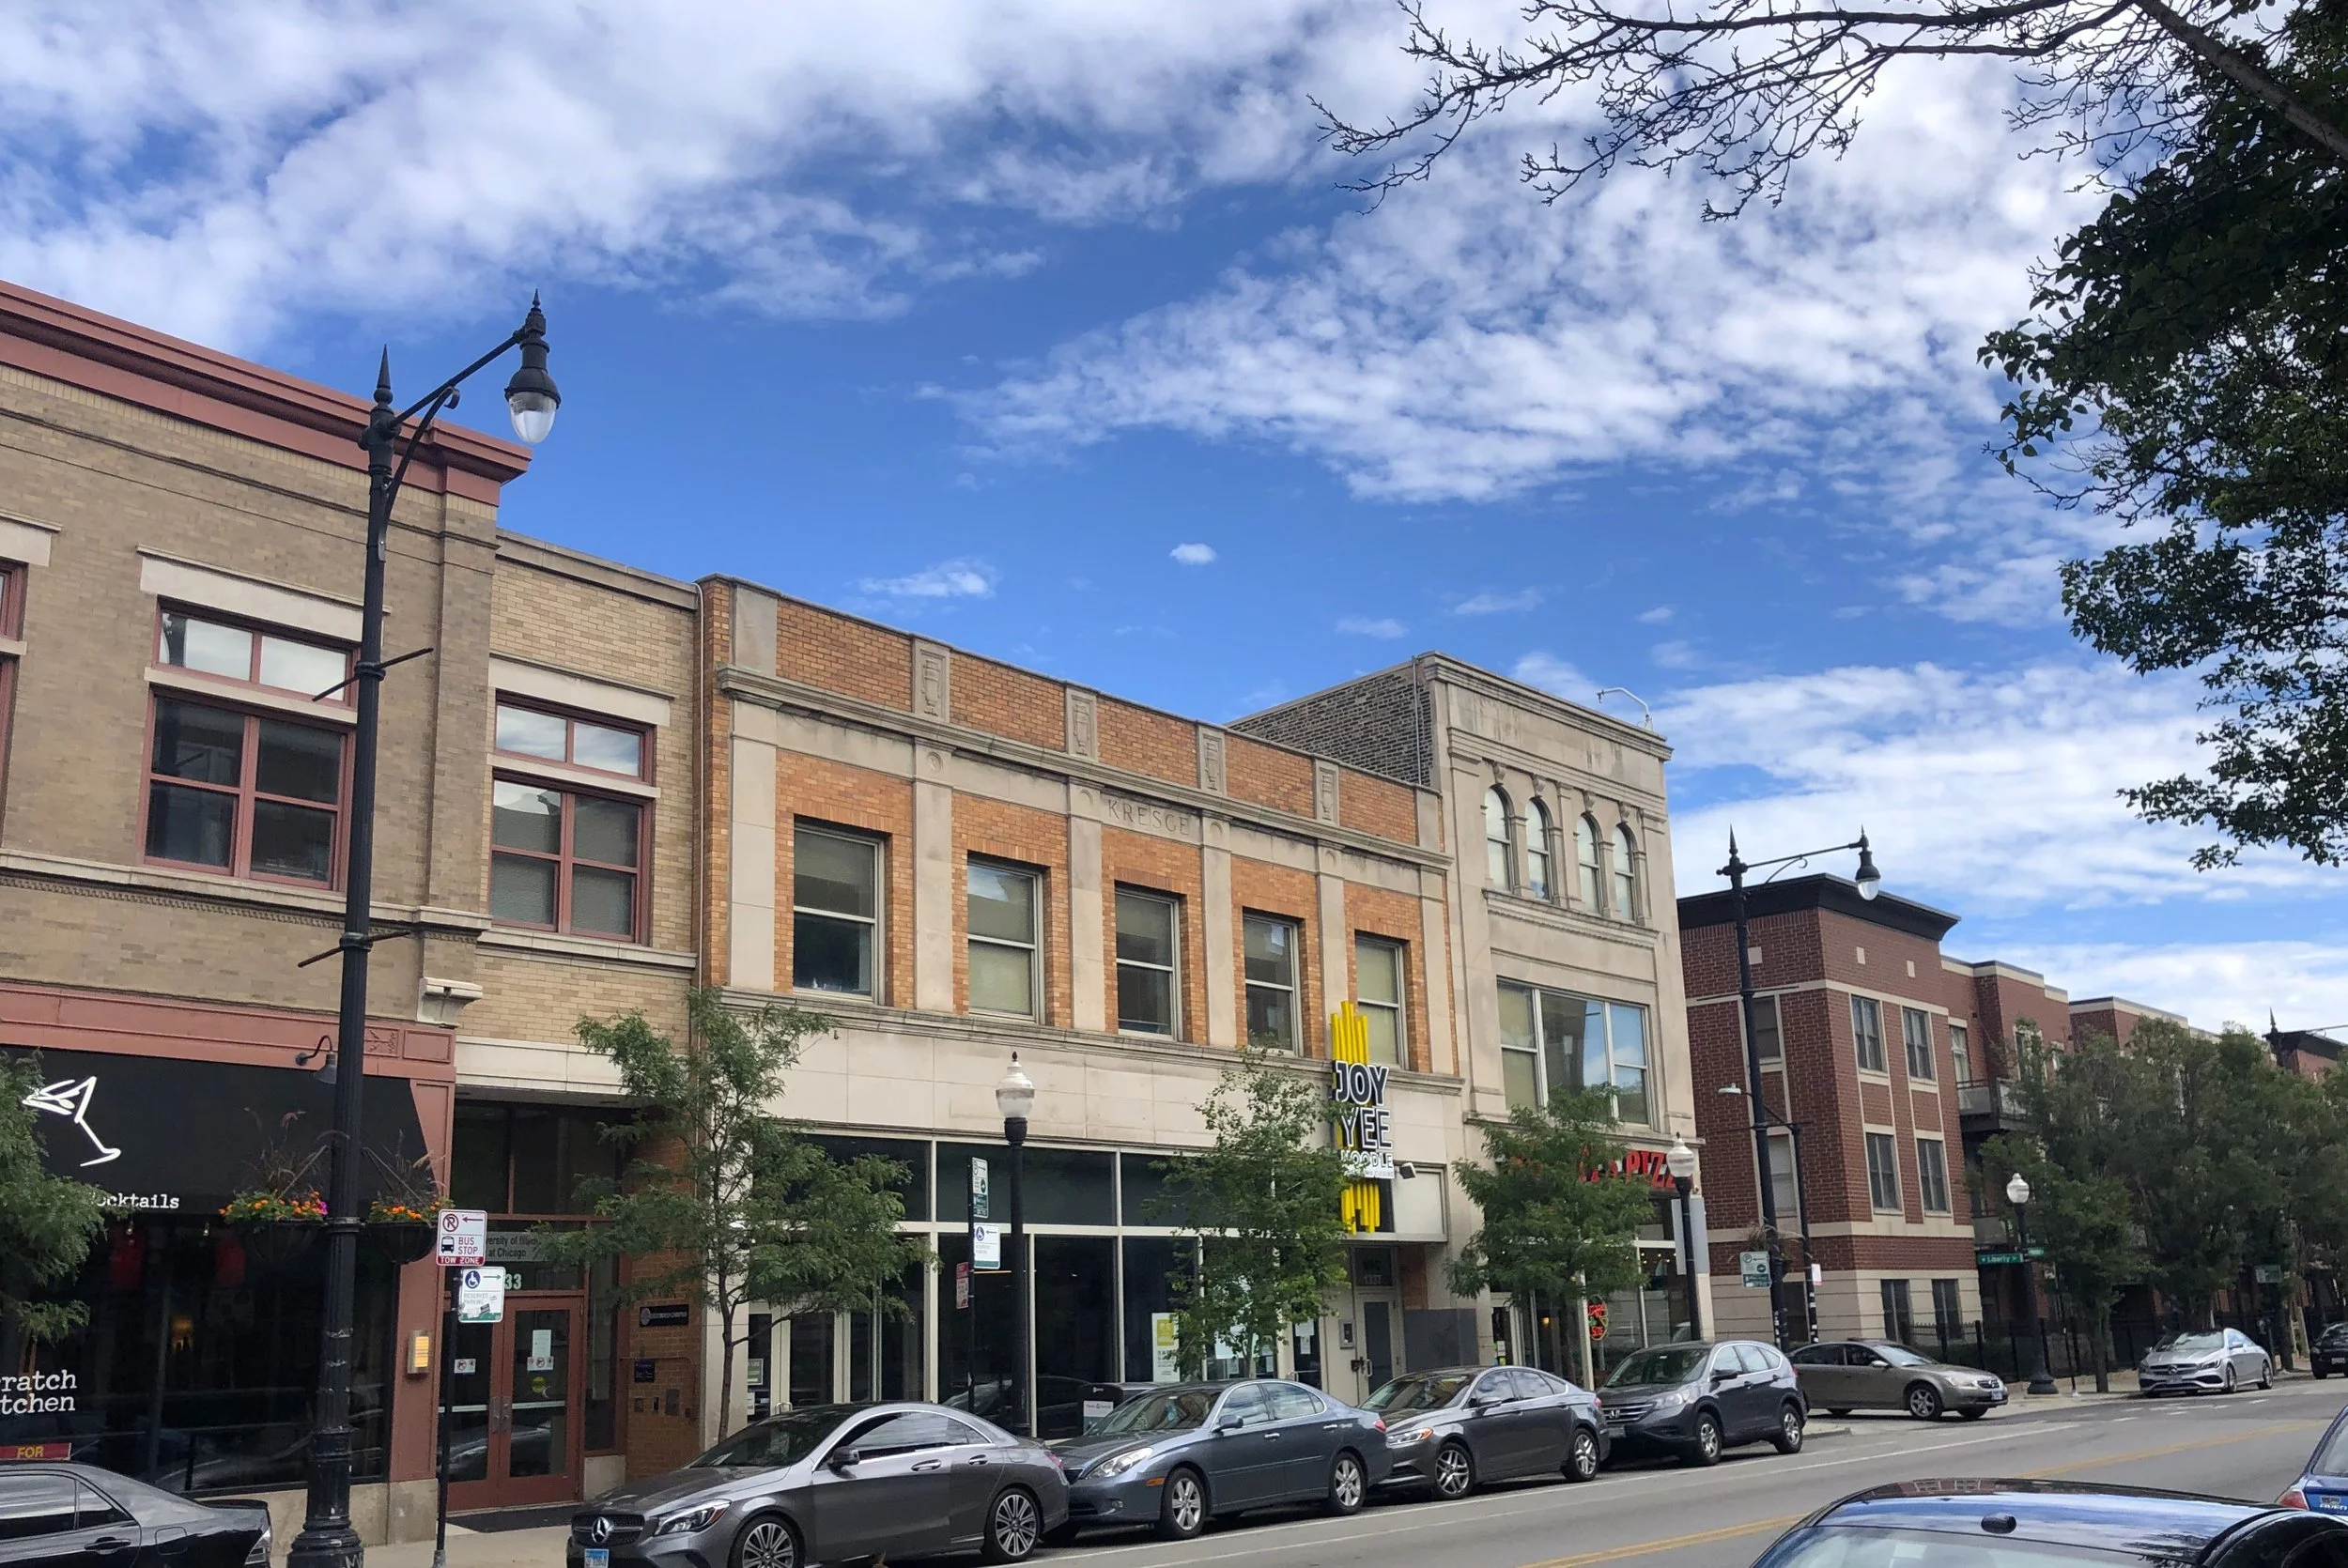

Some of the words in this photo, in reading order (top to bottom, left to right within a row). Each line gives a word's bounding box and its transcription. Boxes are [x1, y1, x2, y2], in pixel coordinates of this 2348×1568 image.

[1335, 1059, 1389, 1106] JOY
[1340, 1106, 1394, 1149] YEE
[1340, 1149, 1394, 1169] NOODLE
[457, 1237, 475, 1246] BUS
[457, 1246, 479, 1255] STOP
[497, 1248, 527, 1259] Chicago
[440, 1256, 458, 1265] TOW
[459, 1256, 481, 1265] ZONE
[0, 1369, 77, 1391] ratch
[17, 1447, 44, 1458] FOR
